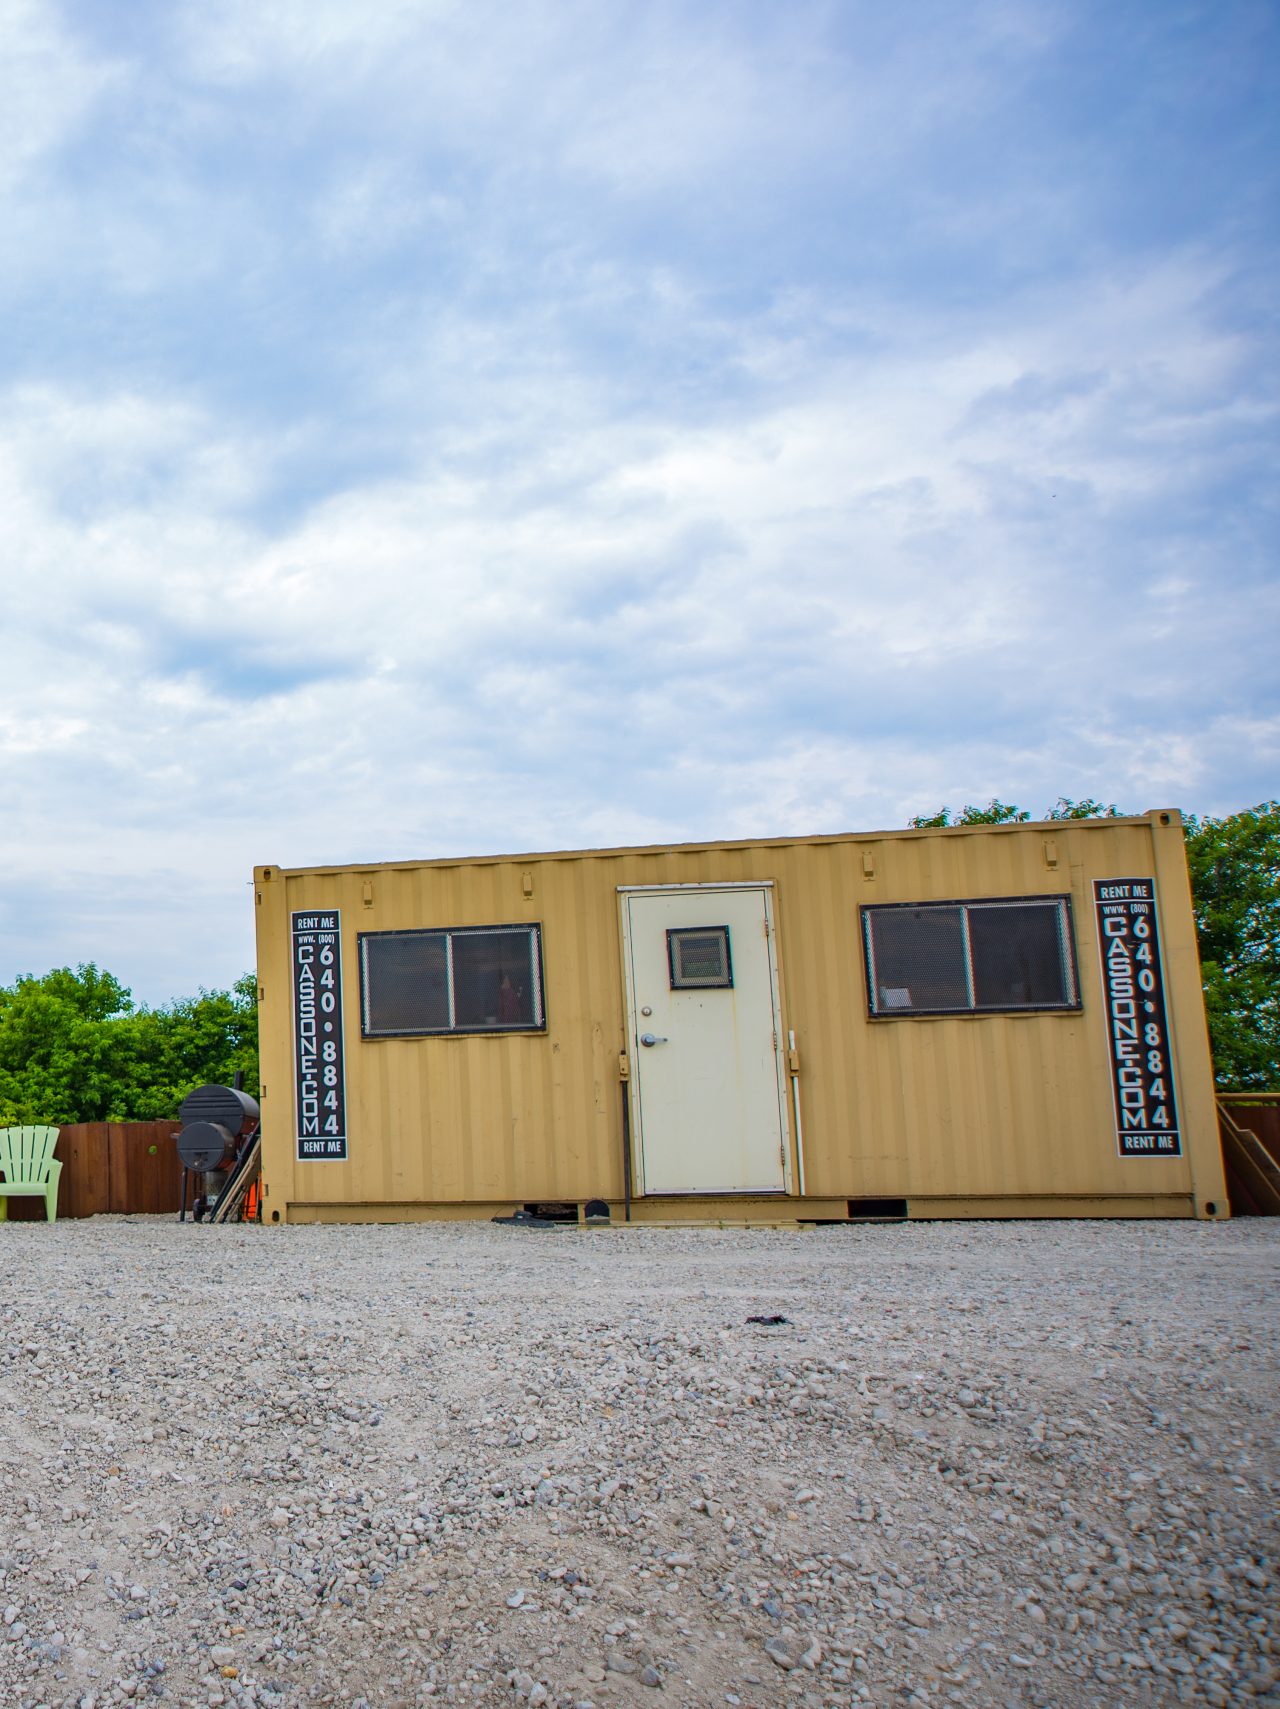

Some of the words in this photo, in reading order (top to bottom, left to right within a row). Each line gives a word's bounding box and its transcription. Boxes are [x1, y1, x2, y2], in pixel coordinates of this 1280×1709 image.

[1101, 886, 1130, 899] RENT
[1132, 885, 1148, 897] ME
[1130, 903, 1149, 913] (800)
[297, 918, 319, 929] RENT
[320, 917, 335, 928] ME
[318, 934, 335, 944] (800)
[1103, 916, 1148, 1129] CASSONE.COM
[298, 945, 319, 1136] CASSONE.COM
[303, 1142, 326, 1153] RENT
[327, 1141, 341, 1152] ME
[1124, 1136, 1155, 1149] RENT
[1157, 1135, 1174, 1148] ME
